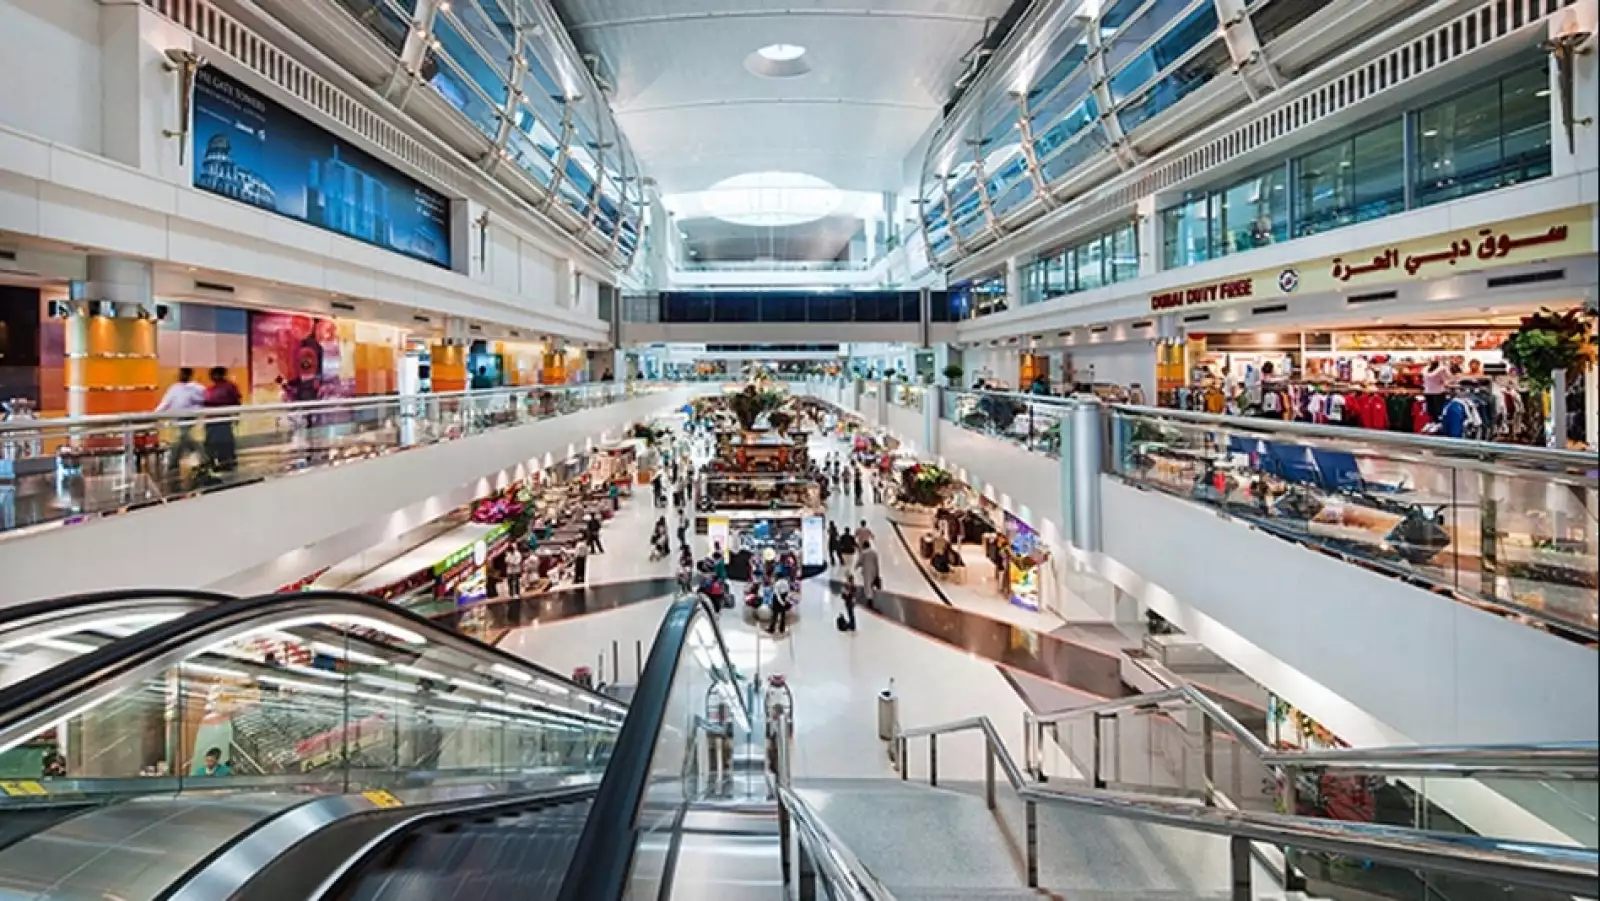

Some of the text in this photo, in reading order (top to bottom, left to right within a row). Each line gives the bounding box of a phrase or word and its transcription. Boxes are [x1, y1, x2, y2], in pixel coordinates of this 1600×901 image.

[1404, 239, 1472, 275] دبي
[1475, 225, 1568, 259] سوق
[1151, 279, 1253, 310] DUBAI DUTY FREE
